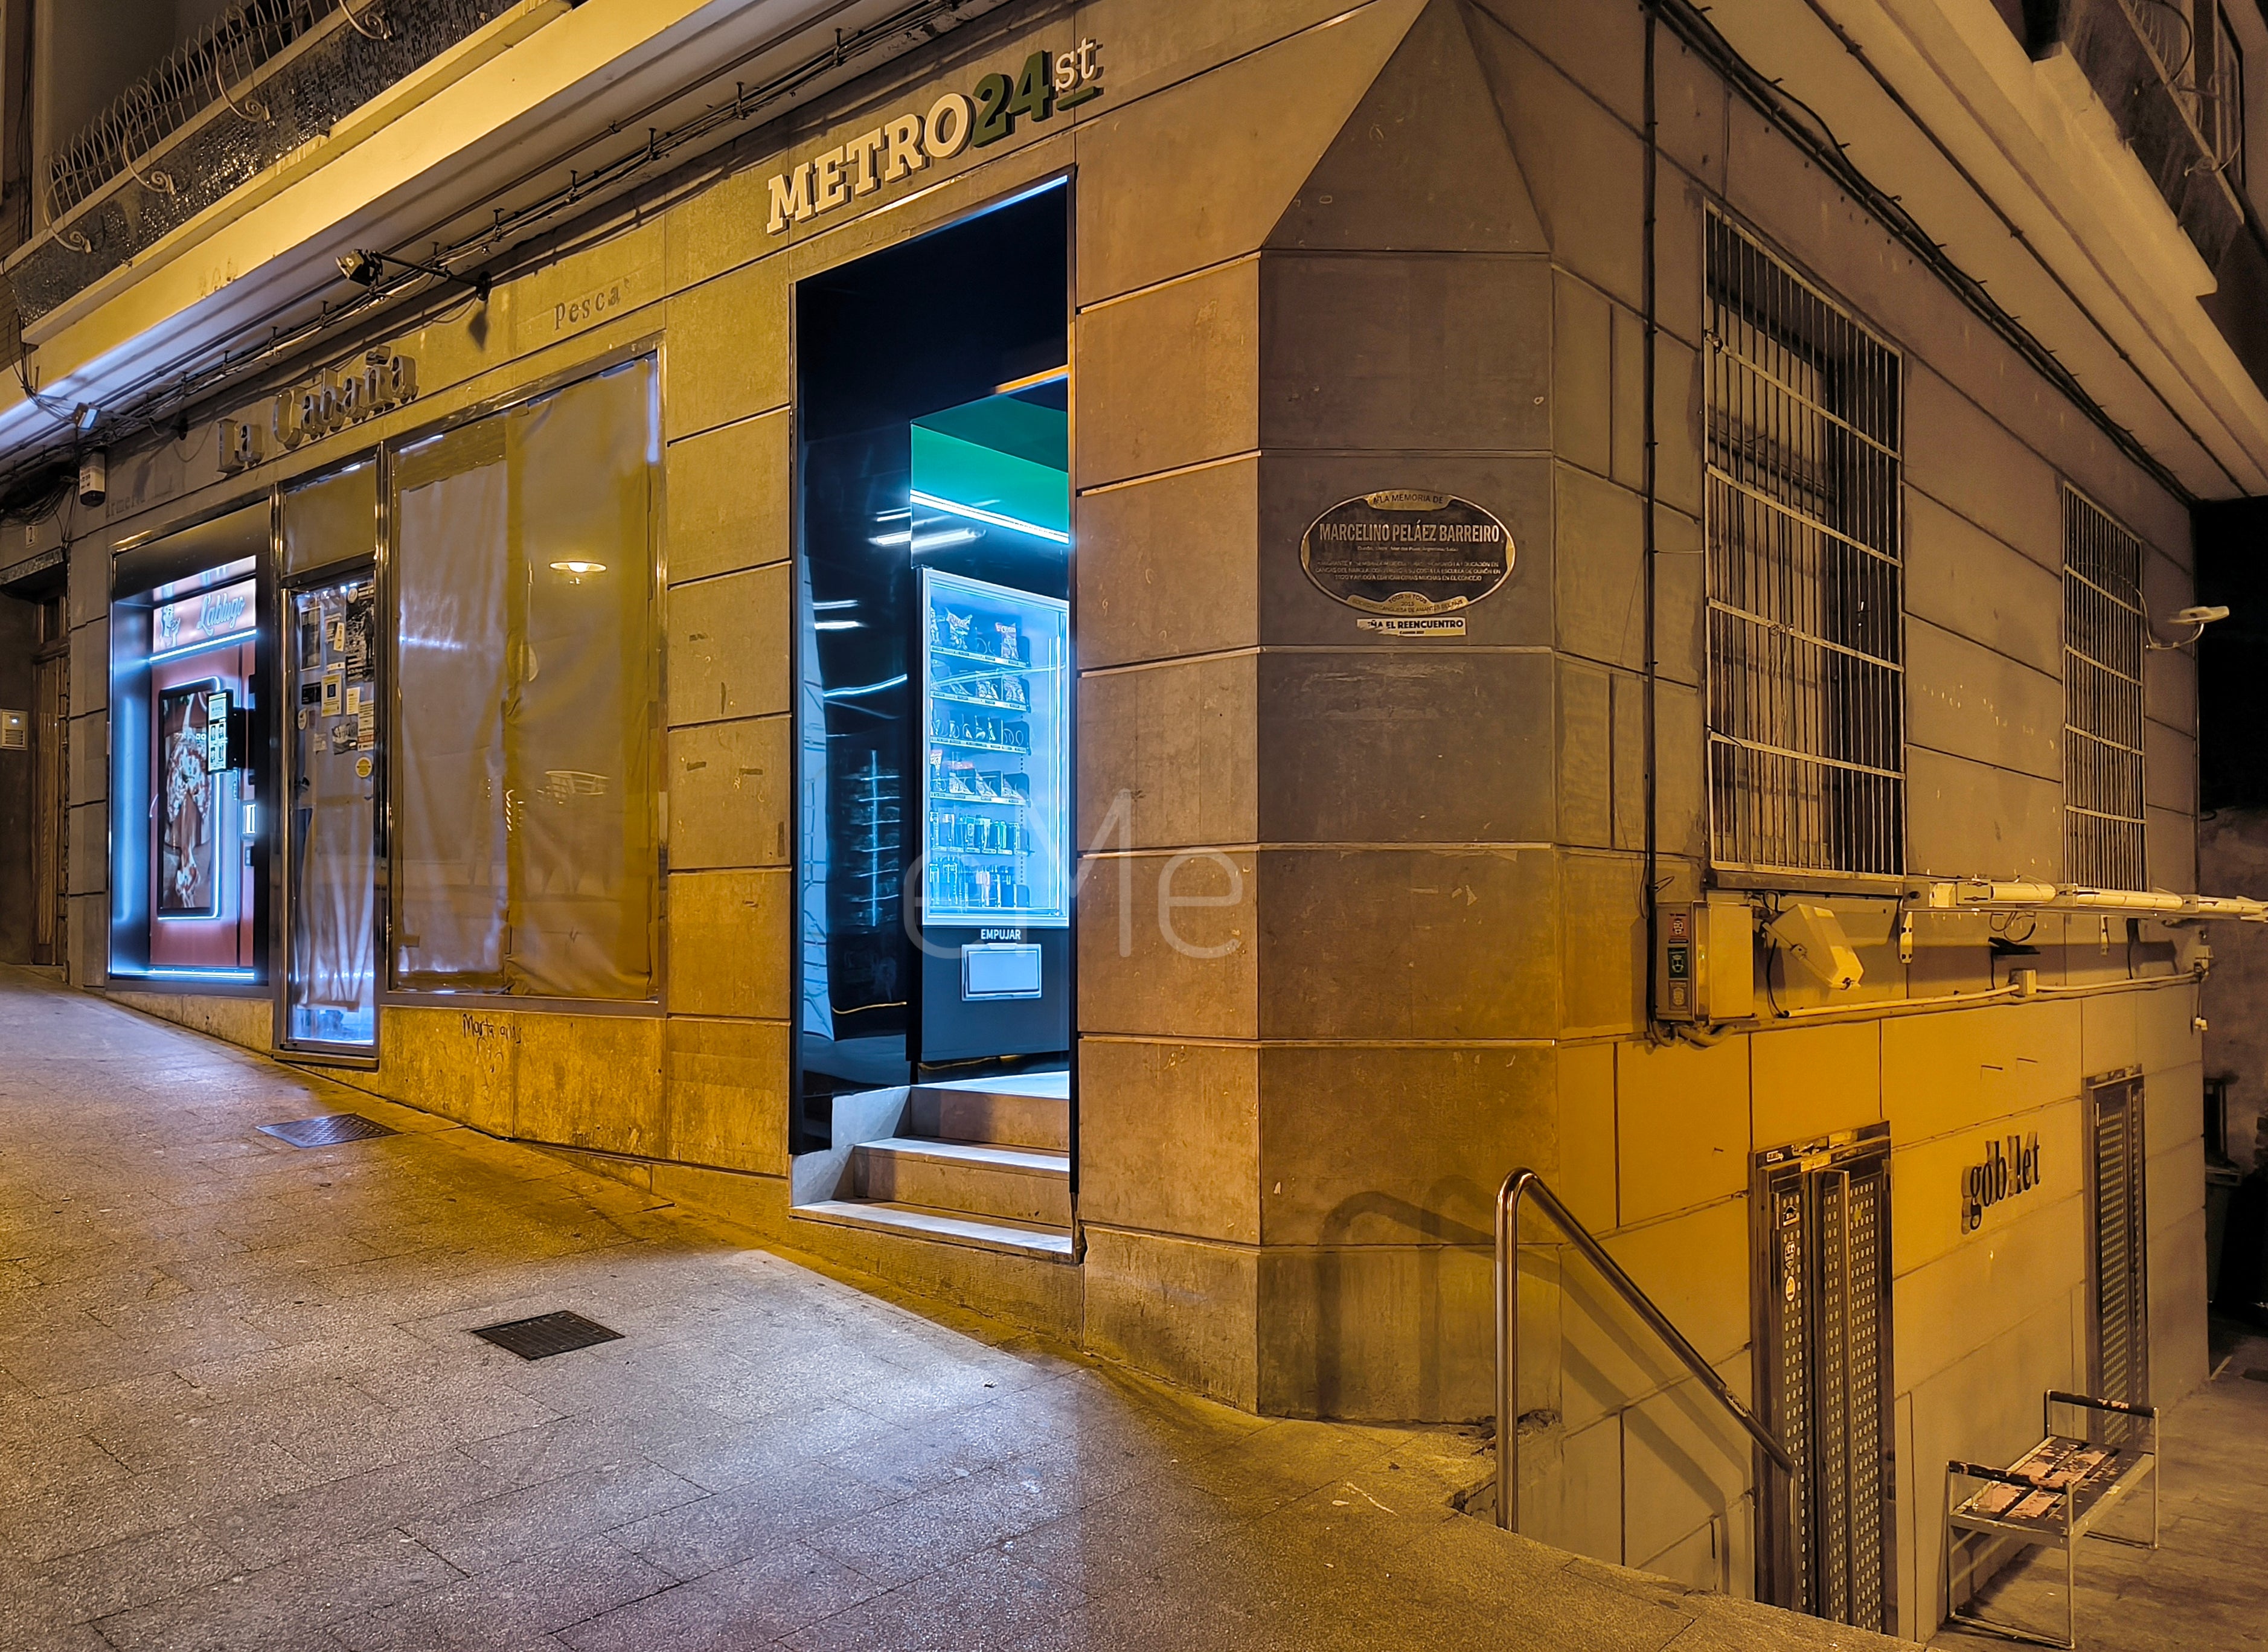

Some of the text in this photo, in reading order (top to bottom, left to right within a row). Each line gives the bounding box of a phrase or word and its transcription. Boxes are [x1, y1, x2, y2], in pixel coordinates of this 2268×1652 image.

[554, 286, 621, 331] Pesca
[273, 345, 419, 450] Cabaña
[1391, 494, 1430, 502] MEMORIA
[1433, 496, 1444, 504] DE
[1319, 519, 1500, 543] MARCELINO PELÁEZ BARREIRO
[1397, 620, 1464, 629] REENCUENTRO
[981, 929, 1022, 940] EMPUJAR
[1964, 1132, 2040, 1232] goblet
